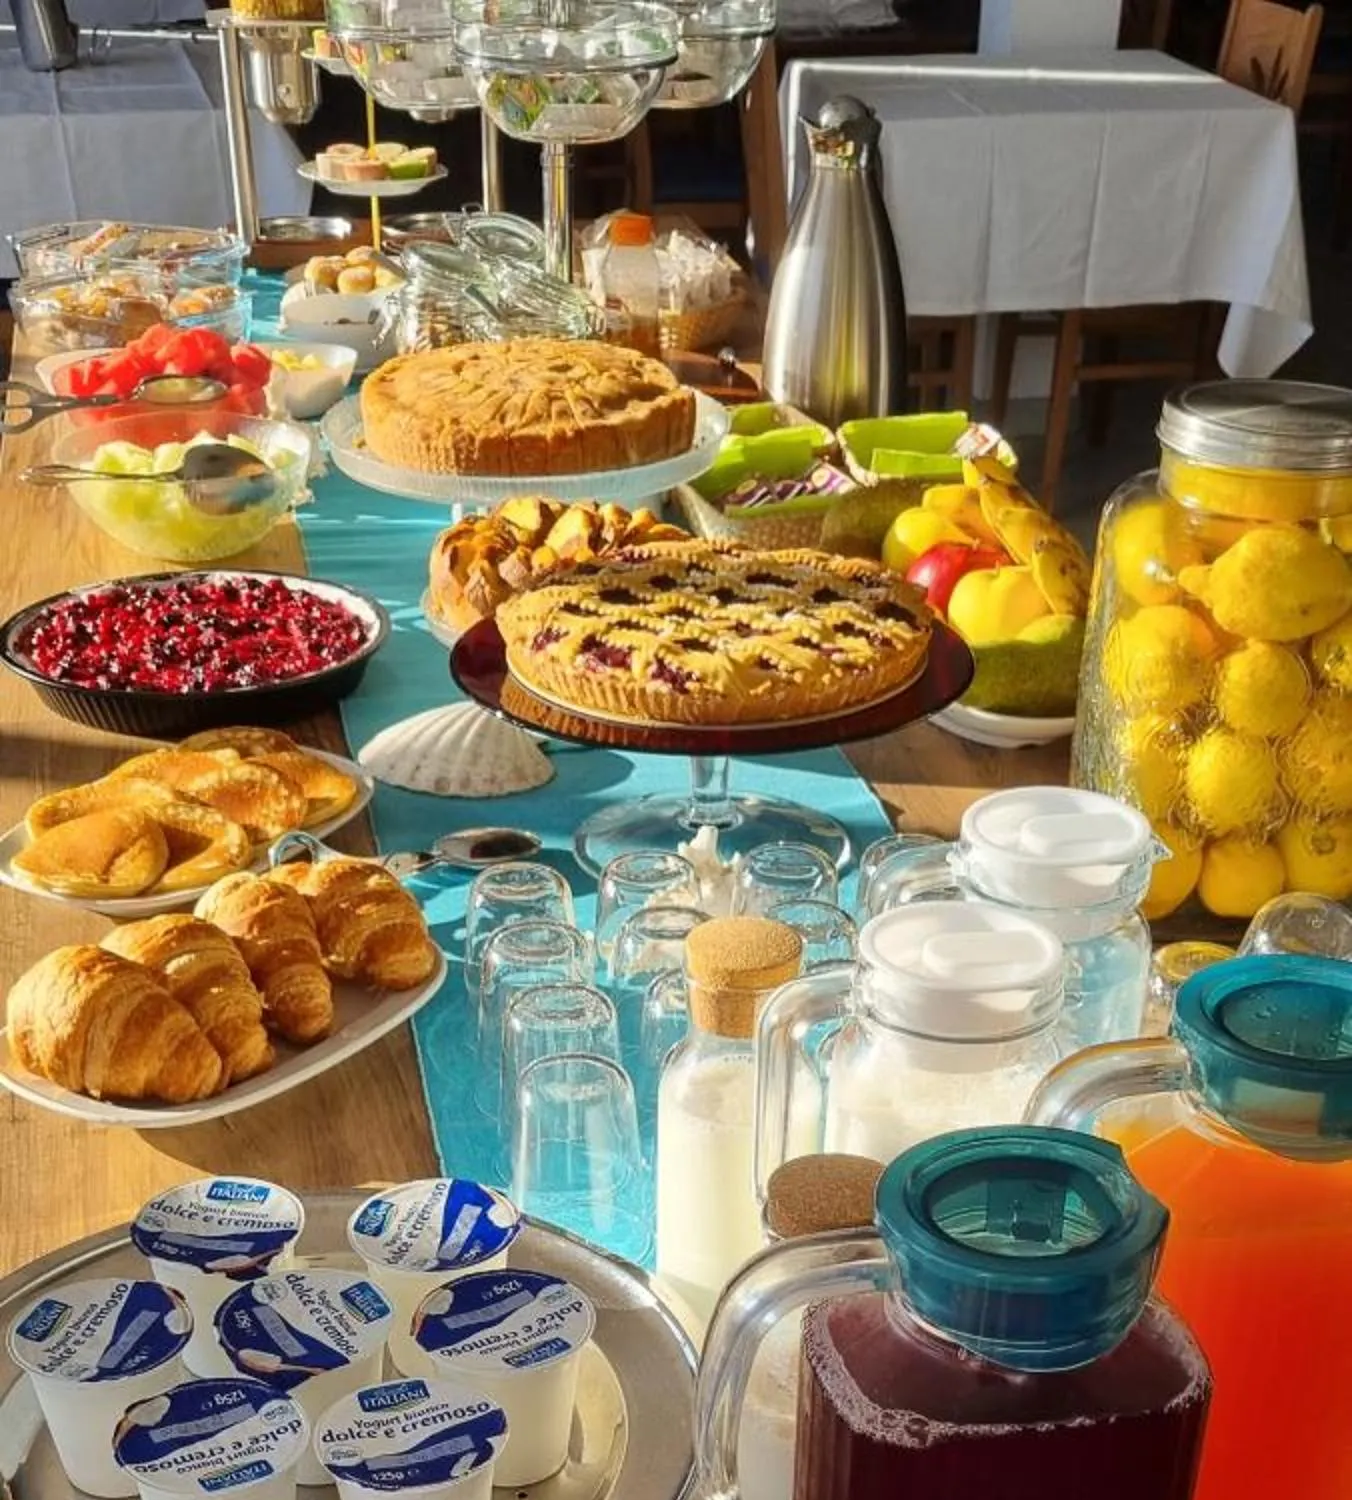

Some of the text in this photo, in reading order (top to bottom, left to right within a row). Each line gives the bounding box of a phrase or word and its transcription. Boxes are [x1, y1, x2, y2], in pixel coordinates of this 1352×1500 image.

[151, 1199, 199, 1222] dolce
[202, 1214, 214, 1224] e
[217, 1216, 295, 1230] cremoso
[285, 1273, 317, 1308] dolce
[82, 1283, 129, 1340] cremoso
[440, 1300, 583, 1358] dolce e cremoso
[215, 1389, 247, 1406] 125g
[362, 1389, 427, 1408] ITALIANI
[321, 1401, 490, 1443] dolce e cremoso
[354, 1402, 449, 1431] Yogurt bianco
[134, 1419, 303, 1474] dolce e cremoso
